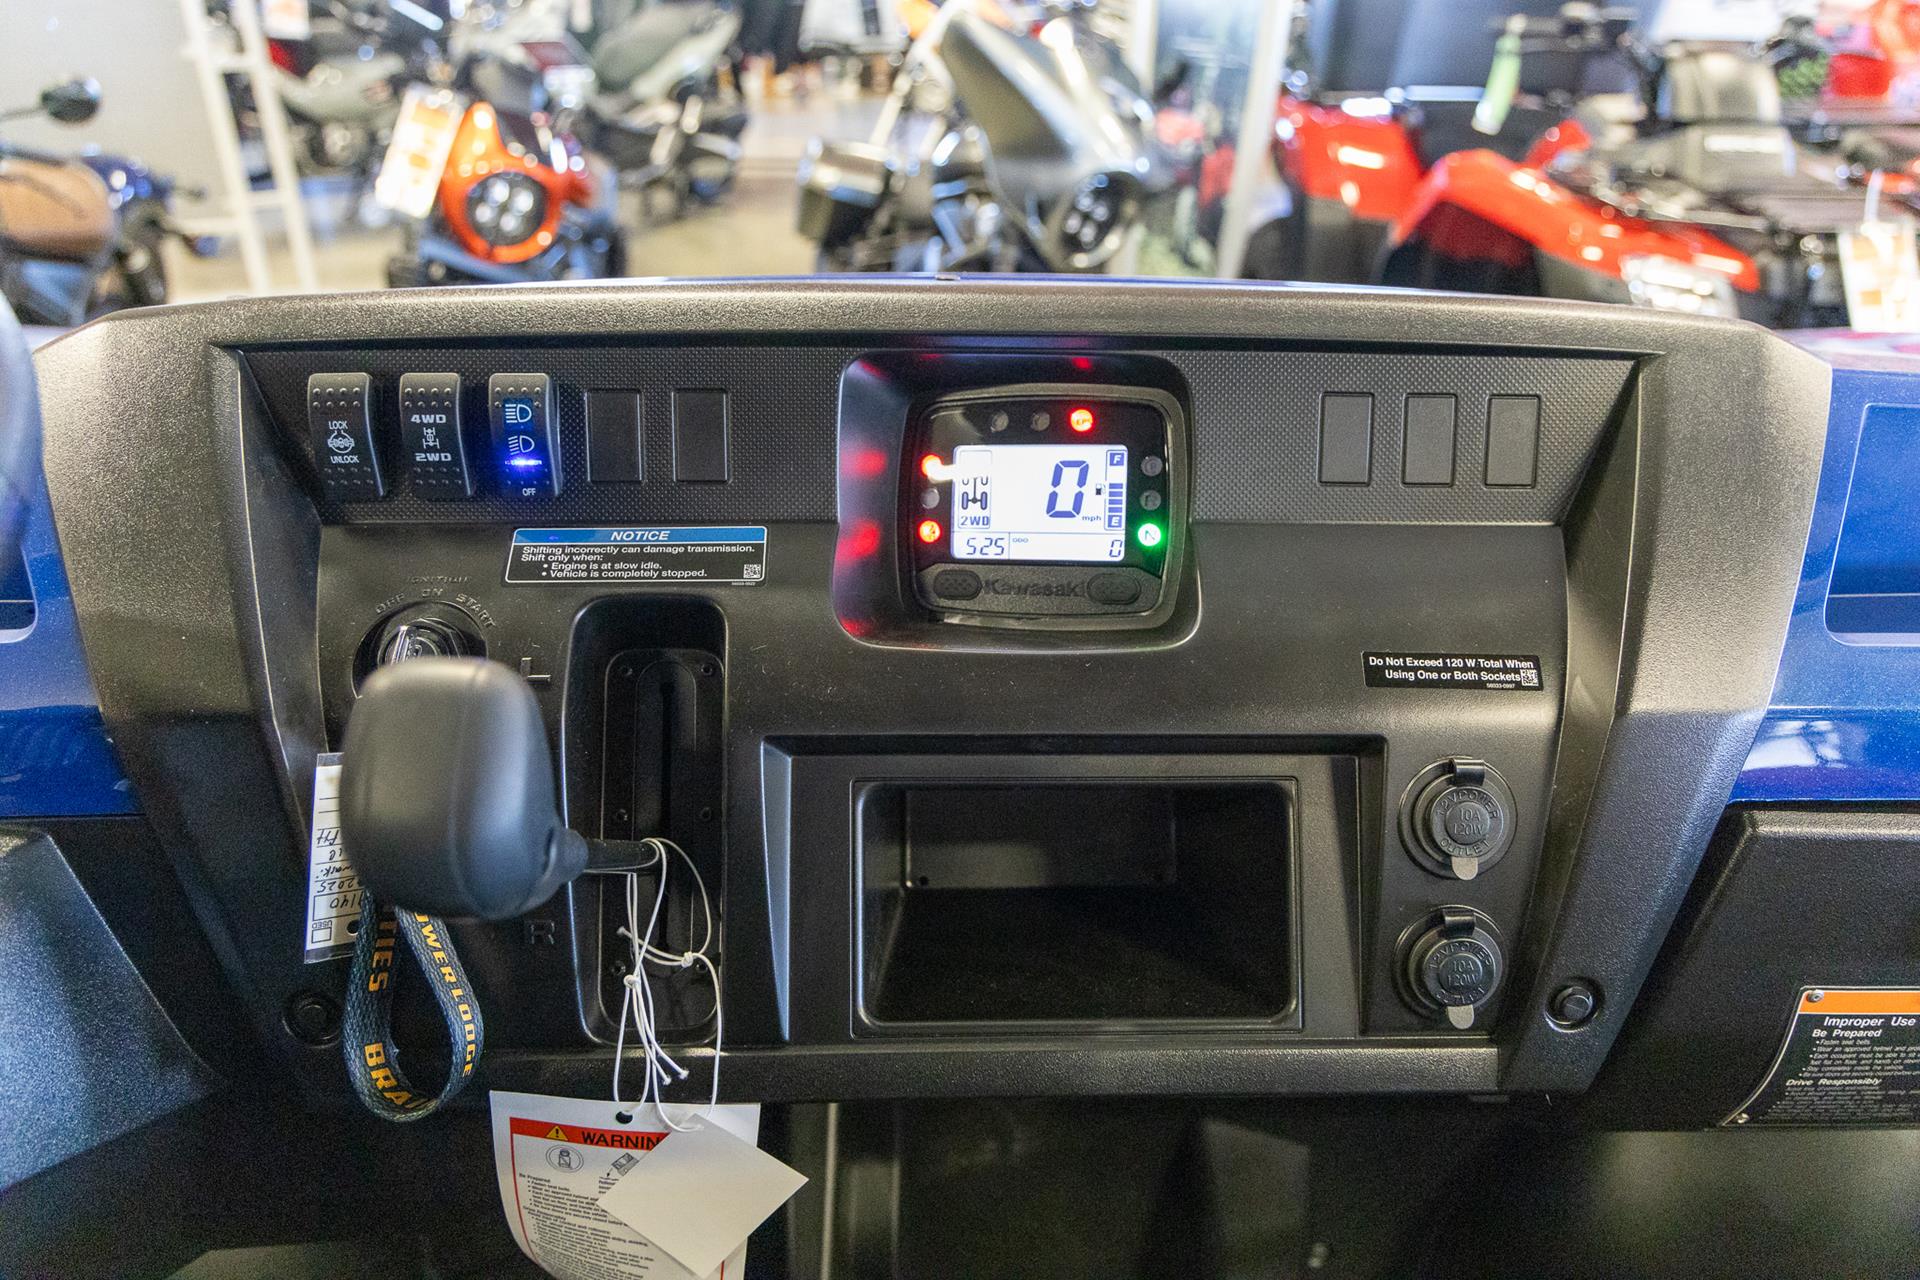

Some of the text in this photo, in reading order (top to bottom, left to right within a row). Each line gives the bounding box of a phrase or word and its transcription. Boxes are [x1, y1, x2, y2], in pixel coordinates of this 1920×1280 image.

[411, 414, 447, 424] 4WD
[328, 420, 348, 430] LOCK
[330, 455, 359, 464] UNLOCK
[415, 453, 451, 462] 2WD
[522, 487, 536, 496] OFF
[1046, 460, 1089, 518] 0
[960, 516, 990, 526] 2WD
[1082, 514, 1102, 522] mph
[610, 531, 671, 541] NOTICE
[522, 546, 562, 555] Shifting
[565, 545, 619, 555] incorrectly
[643, 545, 685, 555] damage
[687, 545, 755, 553] transmission.
[1109, 539, 1123, 558] 0
[521, 553, 603, 563] Shift only when:
[551, 562, 587, 571] Engine
[640, 561, 662, 569] idle.
[550, 569, 707, 579] Vehicle is completely stopped.
[455, 593, 496, 629] START
[1369, 656, 1534, 669] Do Not Exceed 120 W Total When
[1385, 669, 1522, 682] Using One or Both Sockets
[1461, 807, 1481, 821] 10A
[1454, 822, 1484, 836] 120W
[1440, 835, 1490, 856] OUTLET
[312, 920, 332, 930] USED
[1824, 1016, 1916, 1027] Improper Use
[1812, 1029, 1882, 1039] Be Prepared
[1817, 1078, 1882, 1086] Responsibly
[581, 1131, 660, 1150] WARNIN
